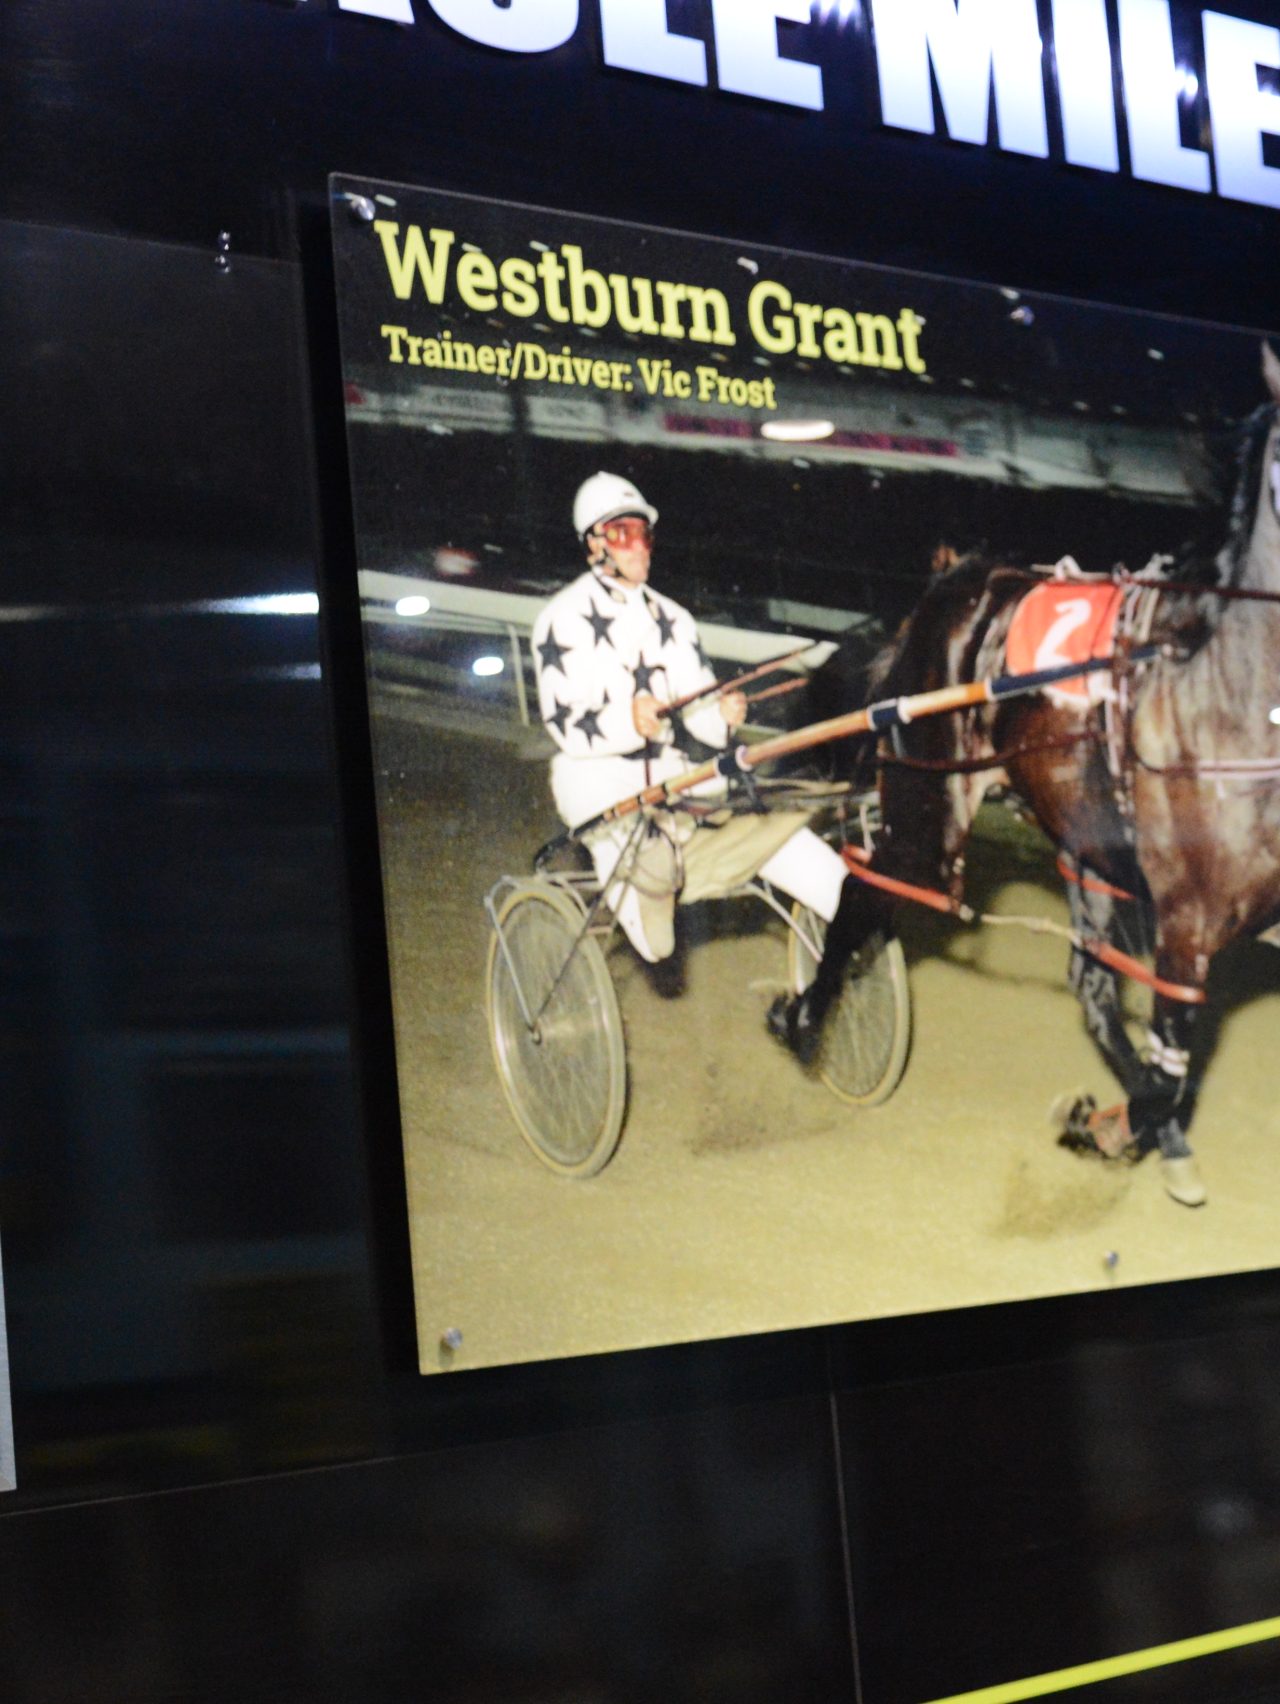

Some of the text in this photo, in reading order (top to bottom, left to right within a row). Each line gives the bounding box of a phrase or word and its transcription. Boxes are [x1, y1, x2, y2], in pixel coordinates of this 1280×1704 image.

[374, 219, 927, 374] Westburn Grant
[381, 324, 778, 410] Trainer/Driver: Vic Frost
[1033, 598, 1092, 670] 2
